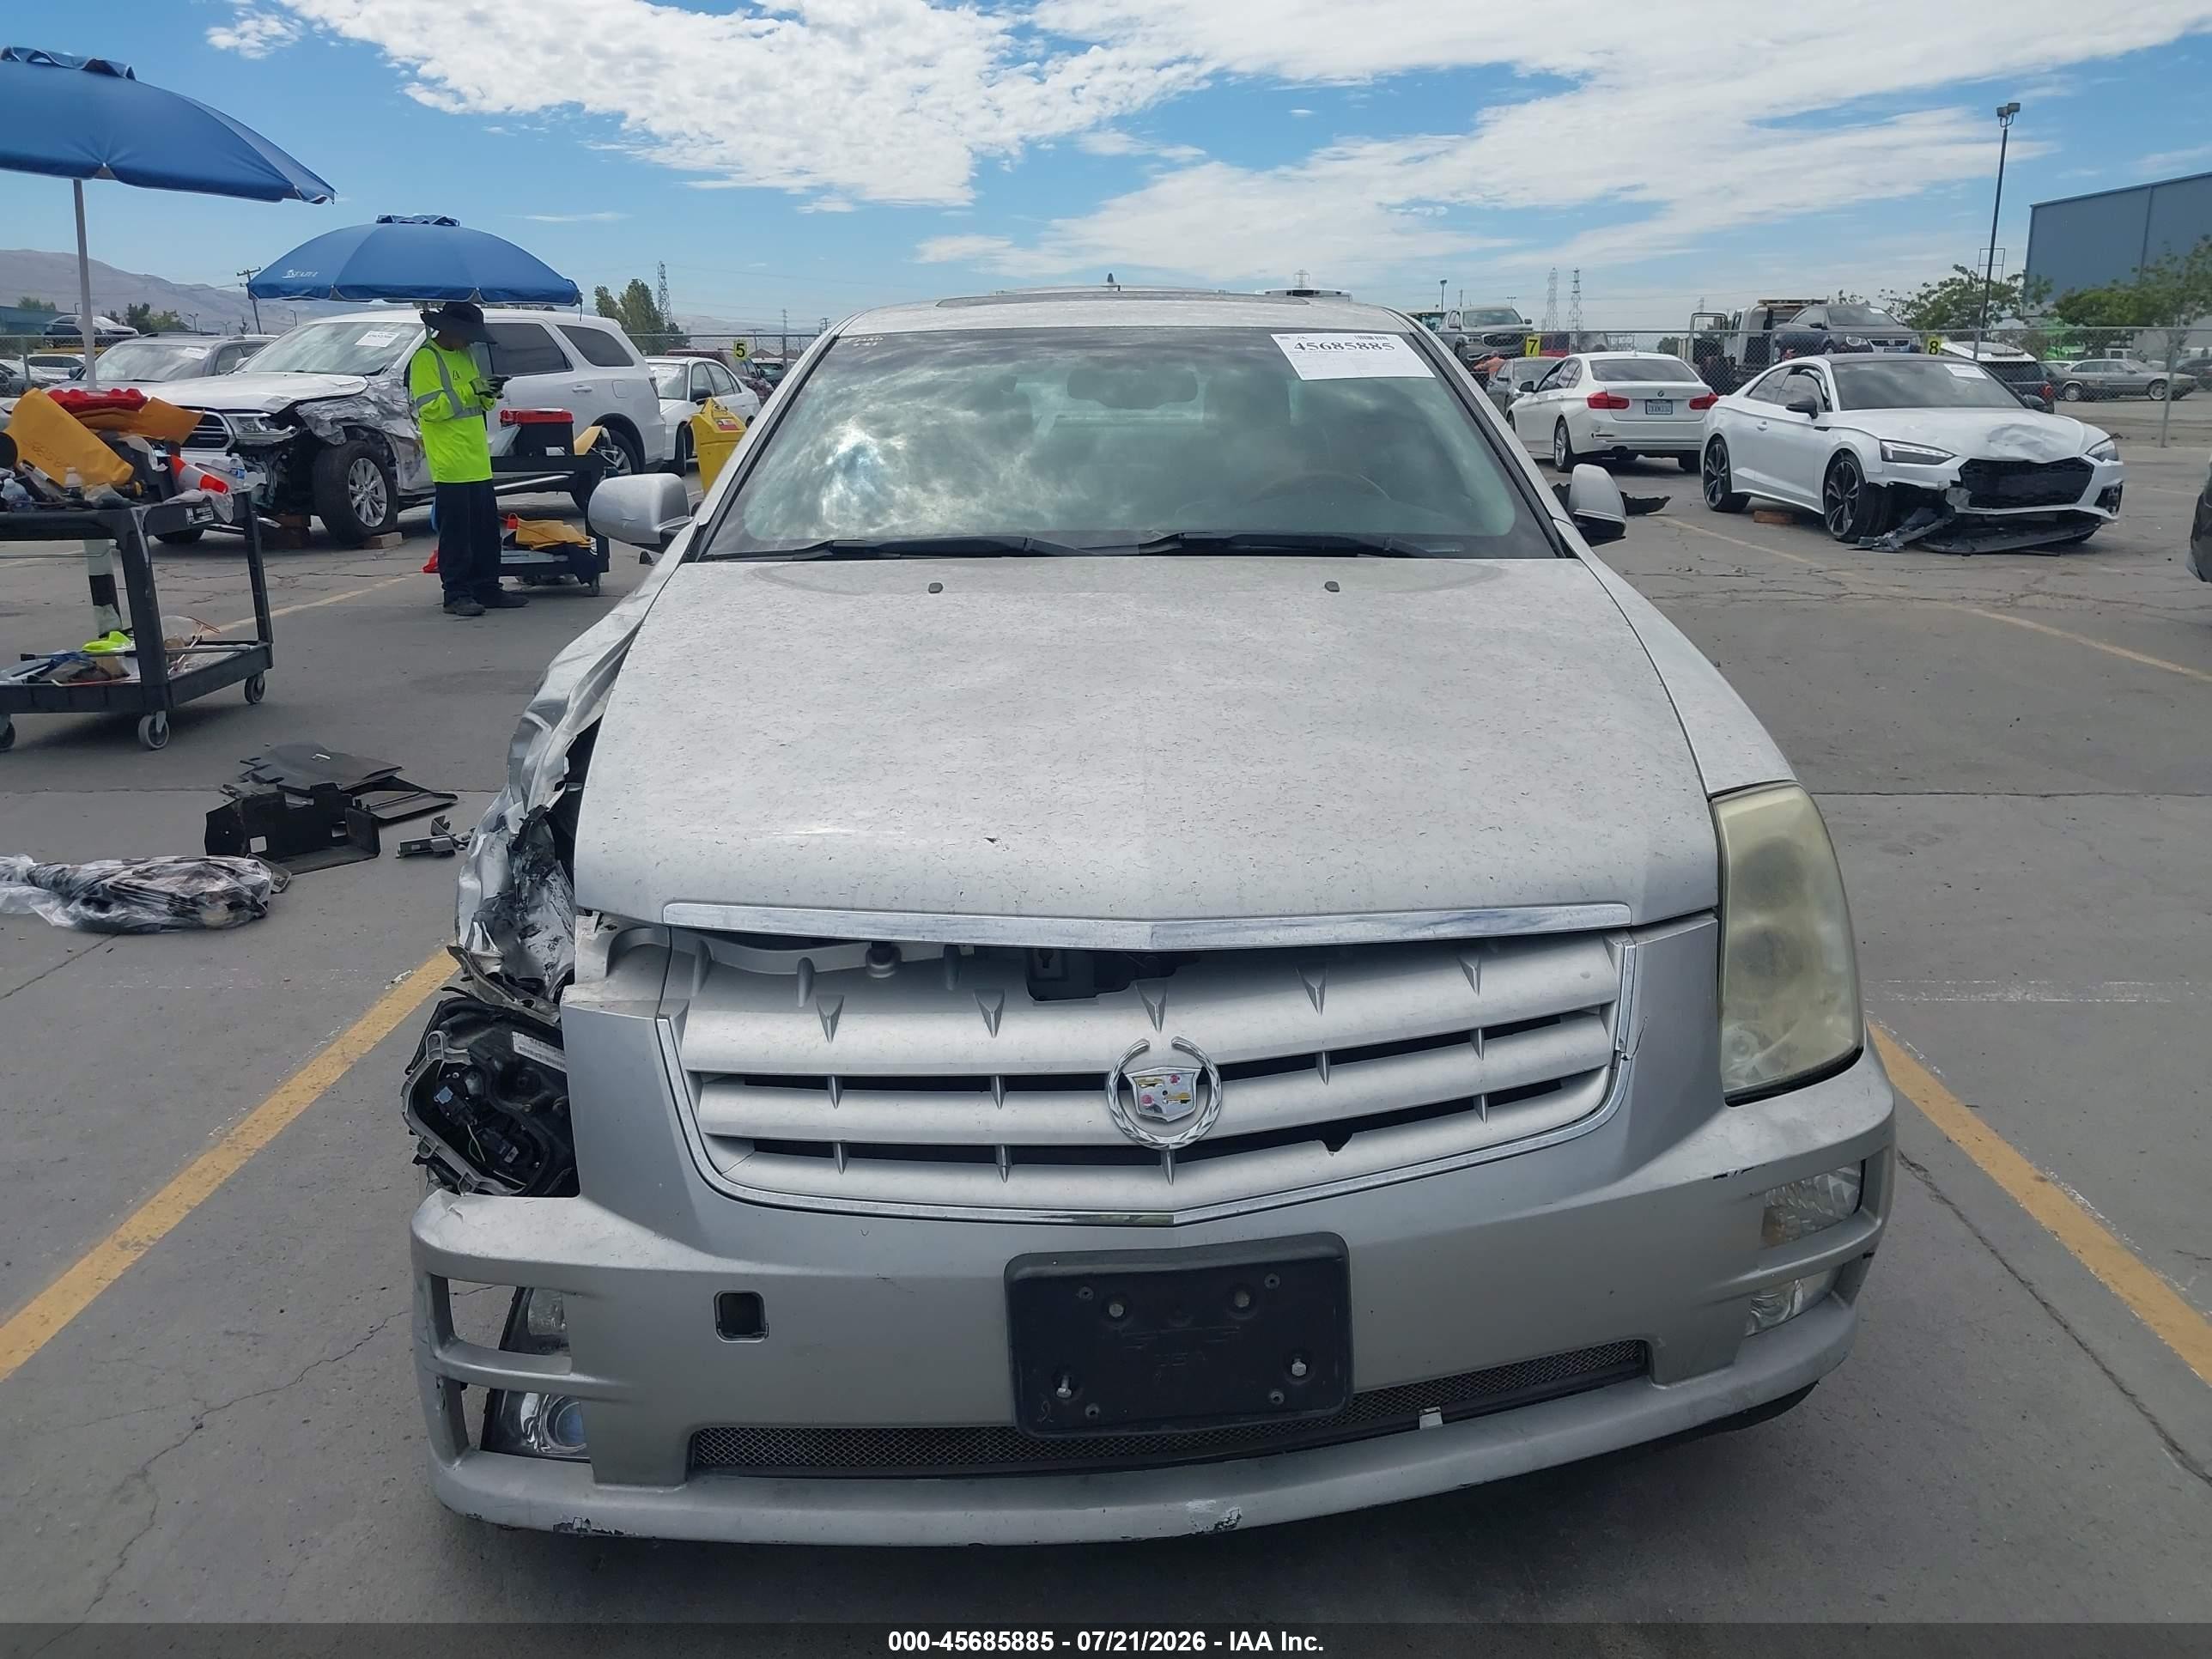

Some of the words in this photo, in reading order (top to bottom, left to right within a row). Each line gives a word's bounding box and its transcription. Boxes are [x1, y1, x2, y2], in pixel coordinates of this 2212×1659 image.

[736, 343, 745, 357] 5
[1293, 342, 1395, 352] 45685885
[1528, 339, 1538, 354] 7
[1929, 341, 1939, 356] 8
